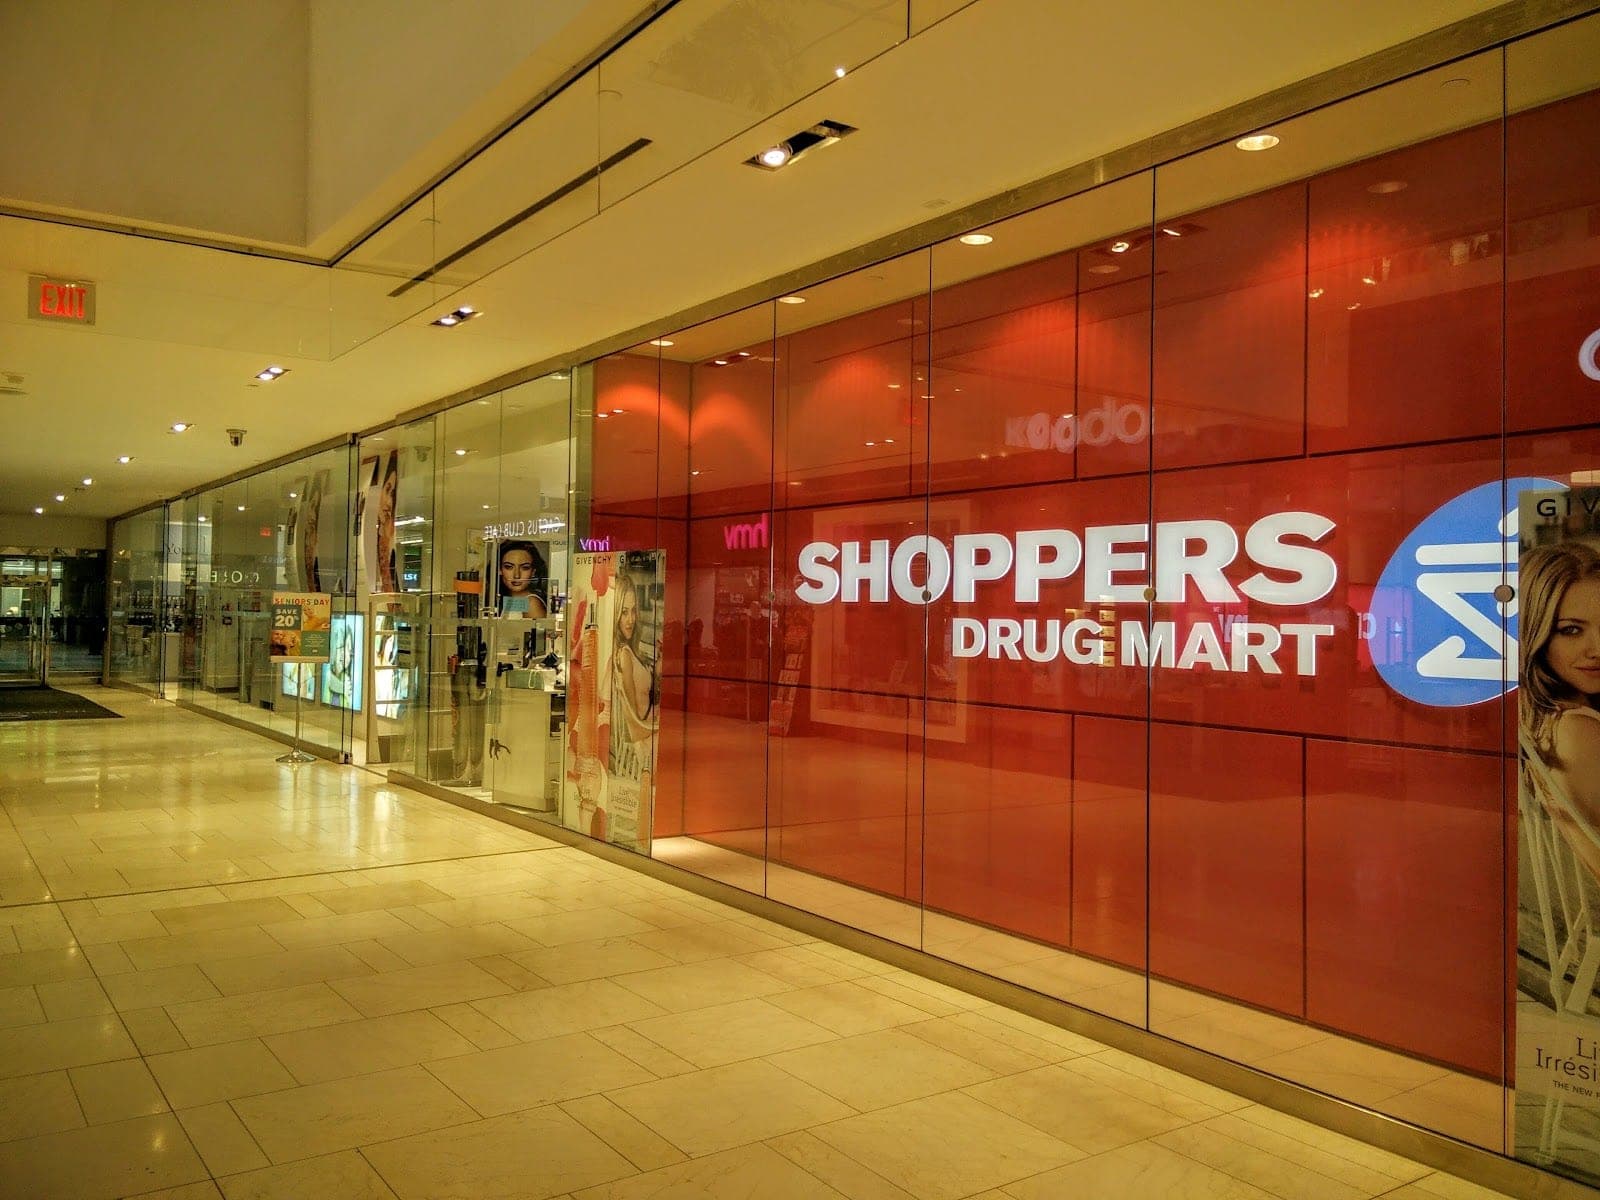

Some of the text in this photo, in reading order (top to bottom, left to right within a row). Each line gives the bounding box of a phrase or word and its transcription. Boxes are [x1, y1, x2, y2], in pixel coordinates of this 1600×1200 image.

[40, 283, 86, 319] EXIT
[576, 556, 612, 565] GIVENCHY
[795, 511, 1338, 606] SHOPPERS
[952, 617, 1104, 665] DRUG
[1121, 620, 1335, 677] MART
[1553, 1080, 1570, 1091] THE
[1572, 1085, 1593, 1097] NEW
